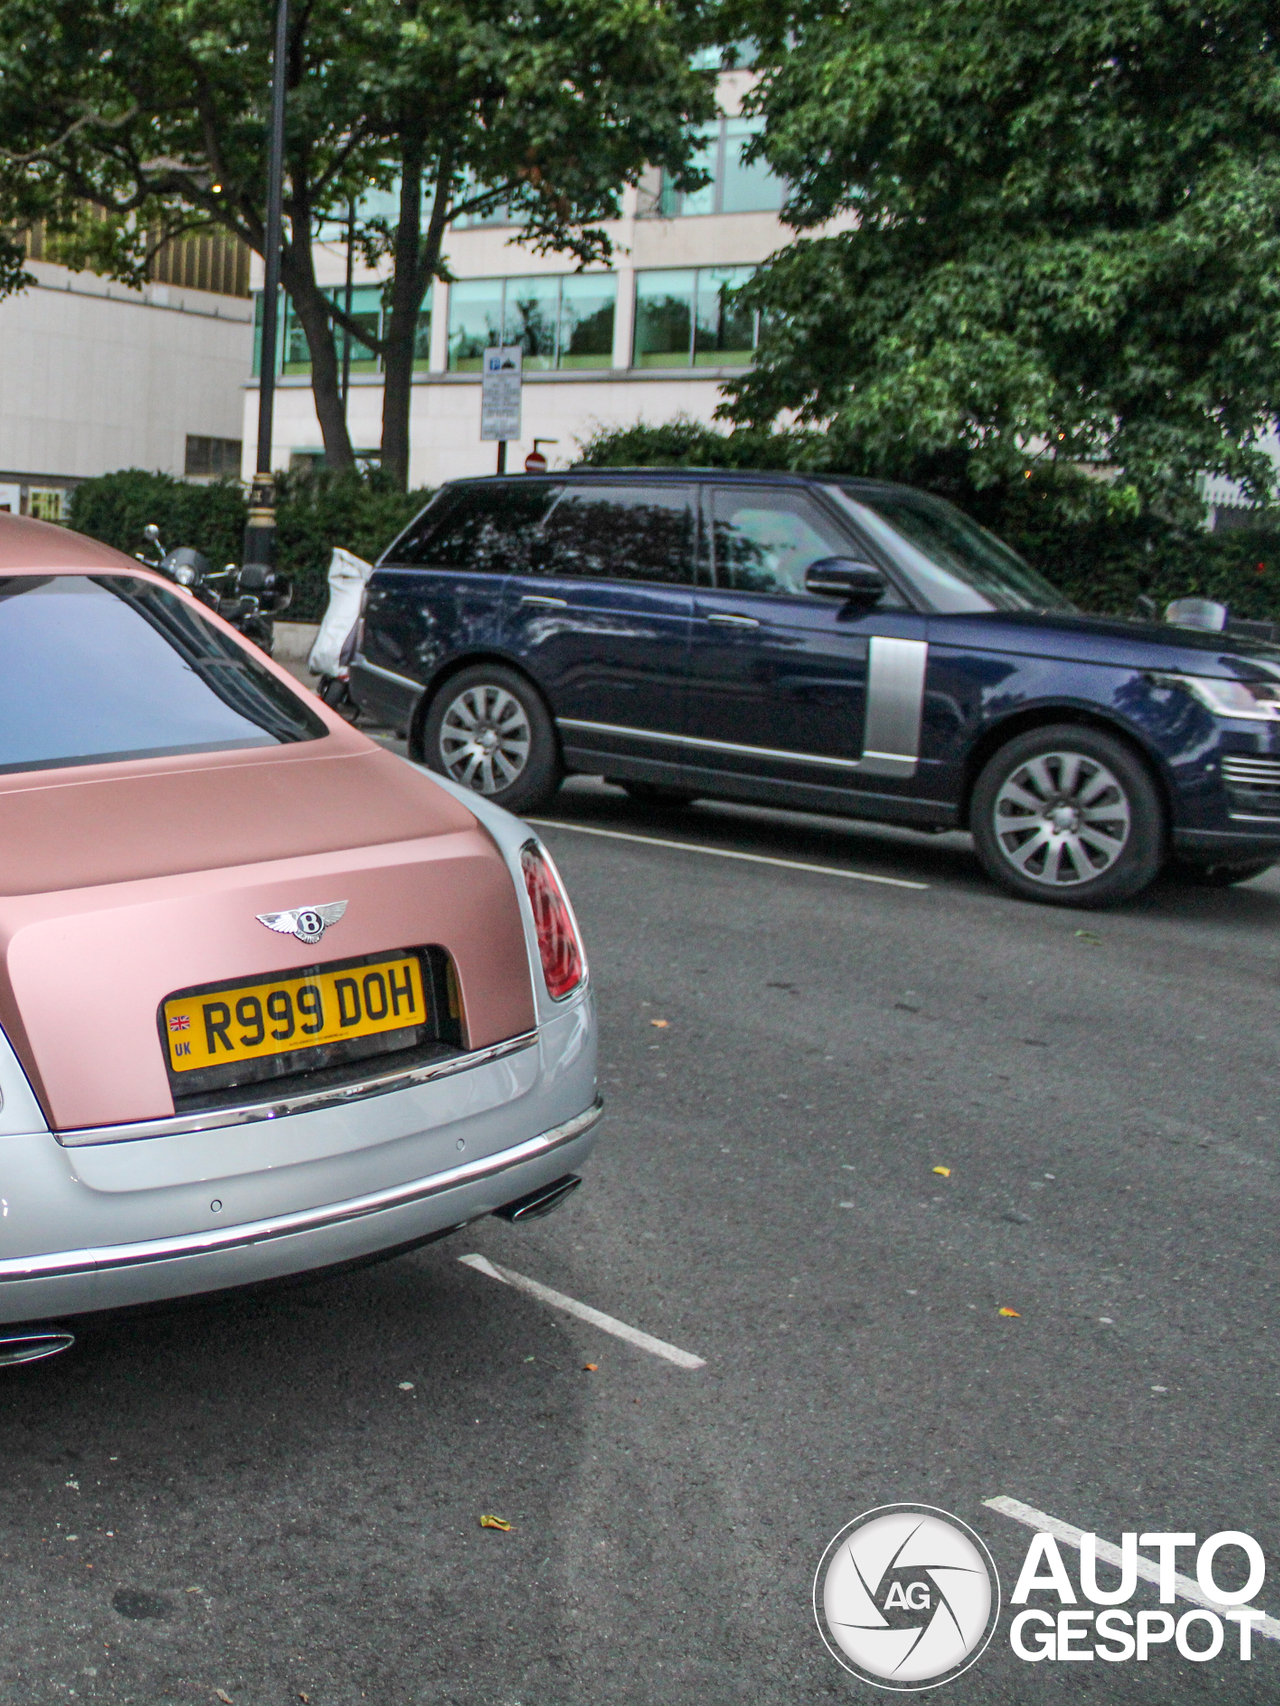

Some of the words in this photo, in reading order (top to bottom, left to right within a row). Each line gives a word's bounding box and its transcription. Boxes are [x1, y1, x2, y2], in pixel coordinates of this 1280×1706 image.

[202, 985, 325, 1054] R999
[334, 965, 416, 1028] DOH
[174, 1042, 192, 1057] UK
